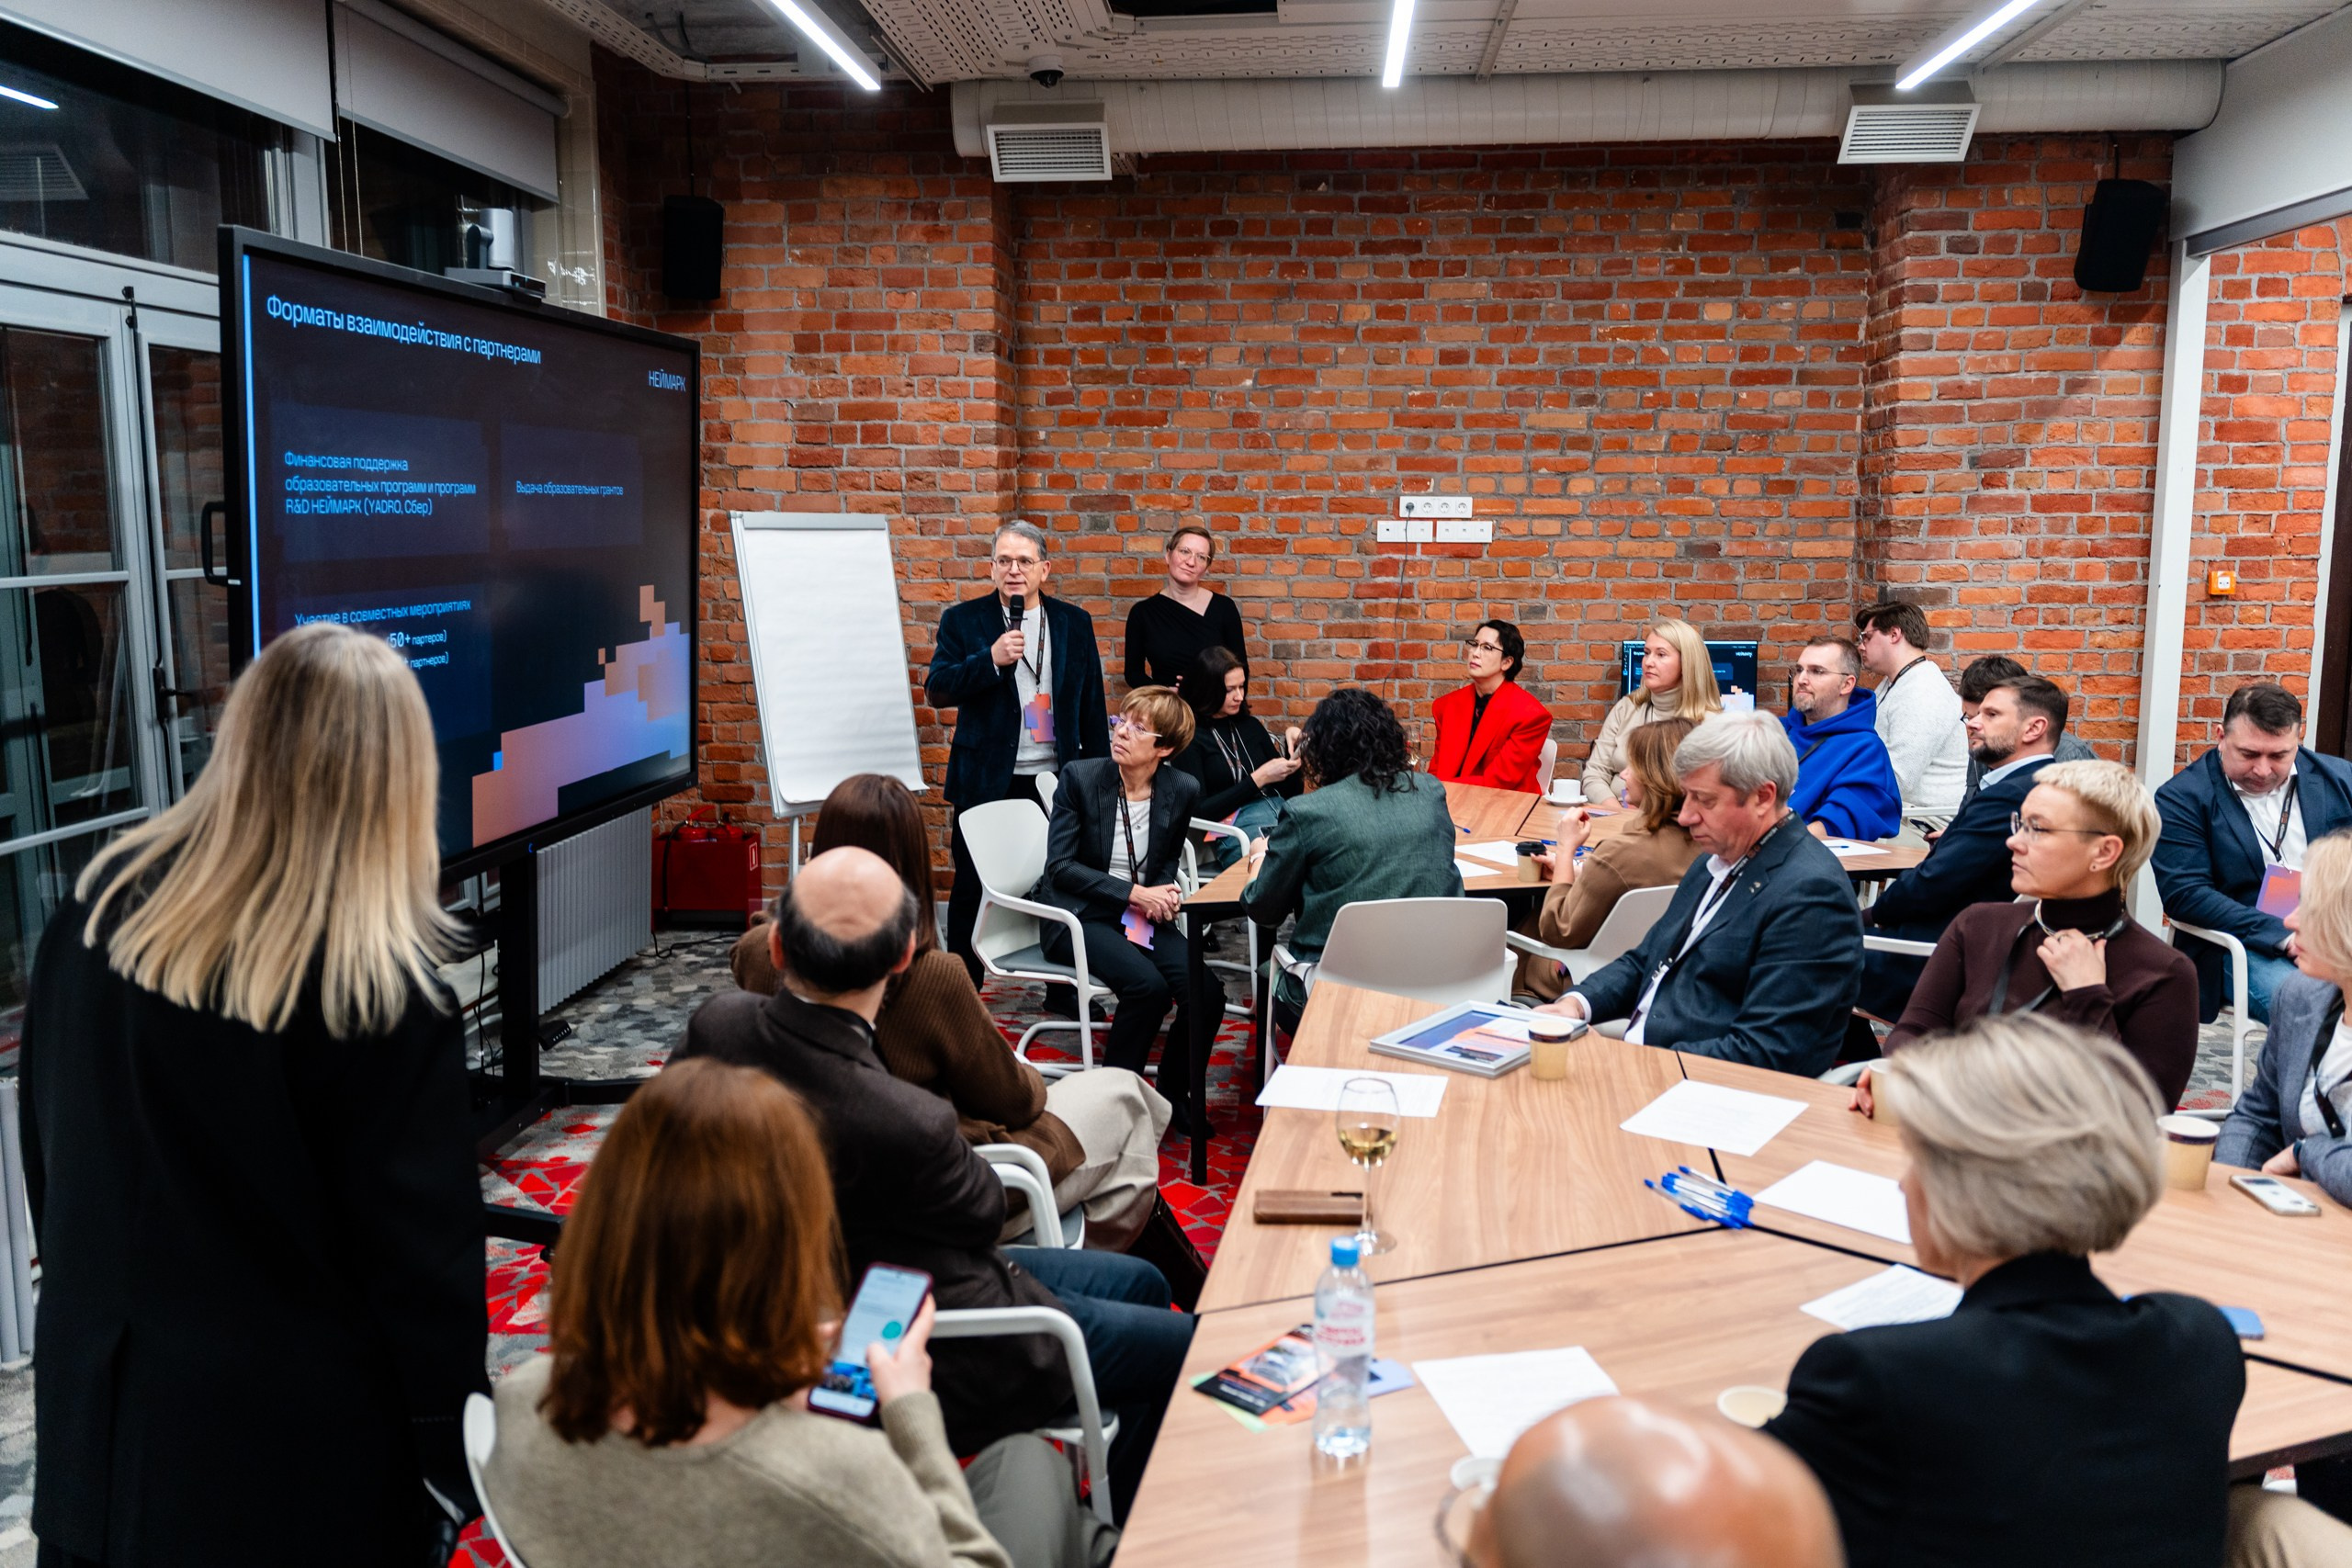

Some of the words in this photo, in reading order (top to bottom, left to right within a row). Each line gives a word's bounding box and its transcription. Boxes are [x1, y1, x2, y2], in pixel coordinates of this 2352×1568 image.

[266, 294, 345, 330] Форматы
[346, 314, 462, 351] взаимодействия
[463, 336, 472, 353] с
[473, 338, 542, 365] партнерами
[648, 368, 686, 392] НЕЙМАРК
[284, 450, 352, 469] Финансовая
[353, 457, 409, 474] поддержка
[285, 475, 379, 496] образовательных
[380, 481, 427, 497] программ
[427, 482, 435, 493] и
[435, 482, 477, 498] программ
[516, 480, 543, 495] Выдача
[544, 481, 600, 497] образовательных
[600, 486, 624, 498] грантов
[286, 498, 311, 514] R&D
[311, 495, 363, 514] НЕЙМАРК
[364, 497, 403, 516] (YADRO,
[404, 498, 433, 517] Сбер)
[294, 613, 341, 629] Участие
[342, 612, 348, 624] в
[349, 607, 409, 623] совместных
[409, 600, 471, 619] мероприятиях
[410, 651, 449, 670] партнеров)
